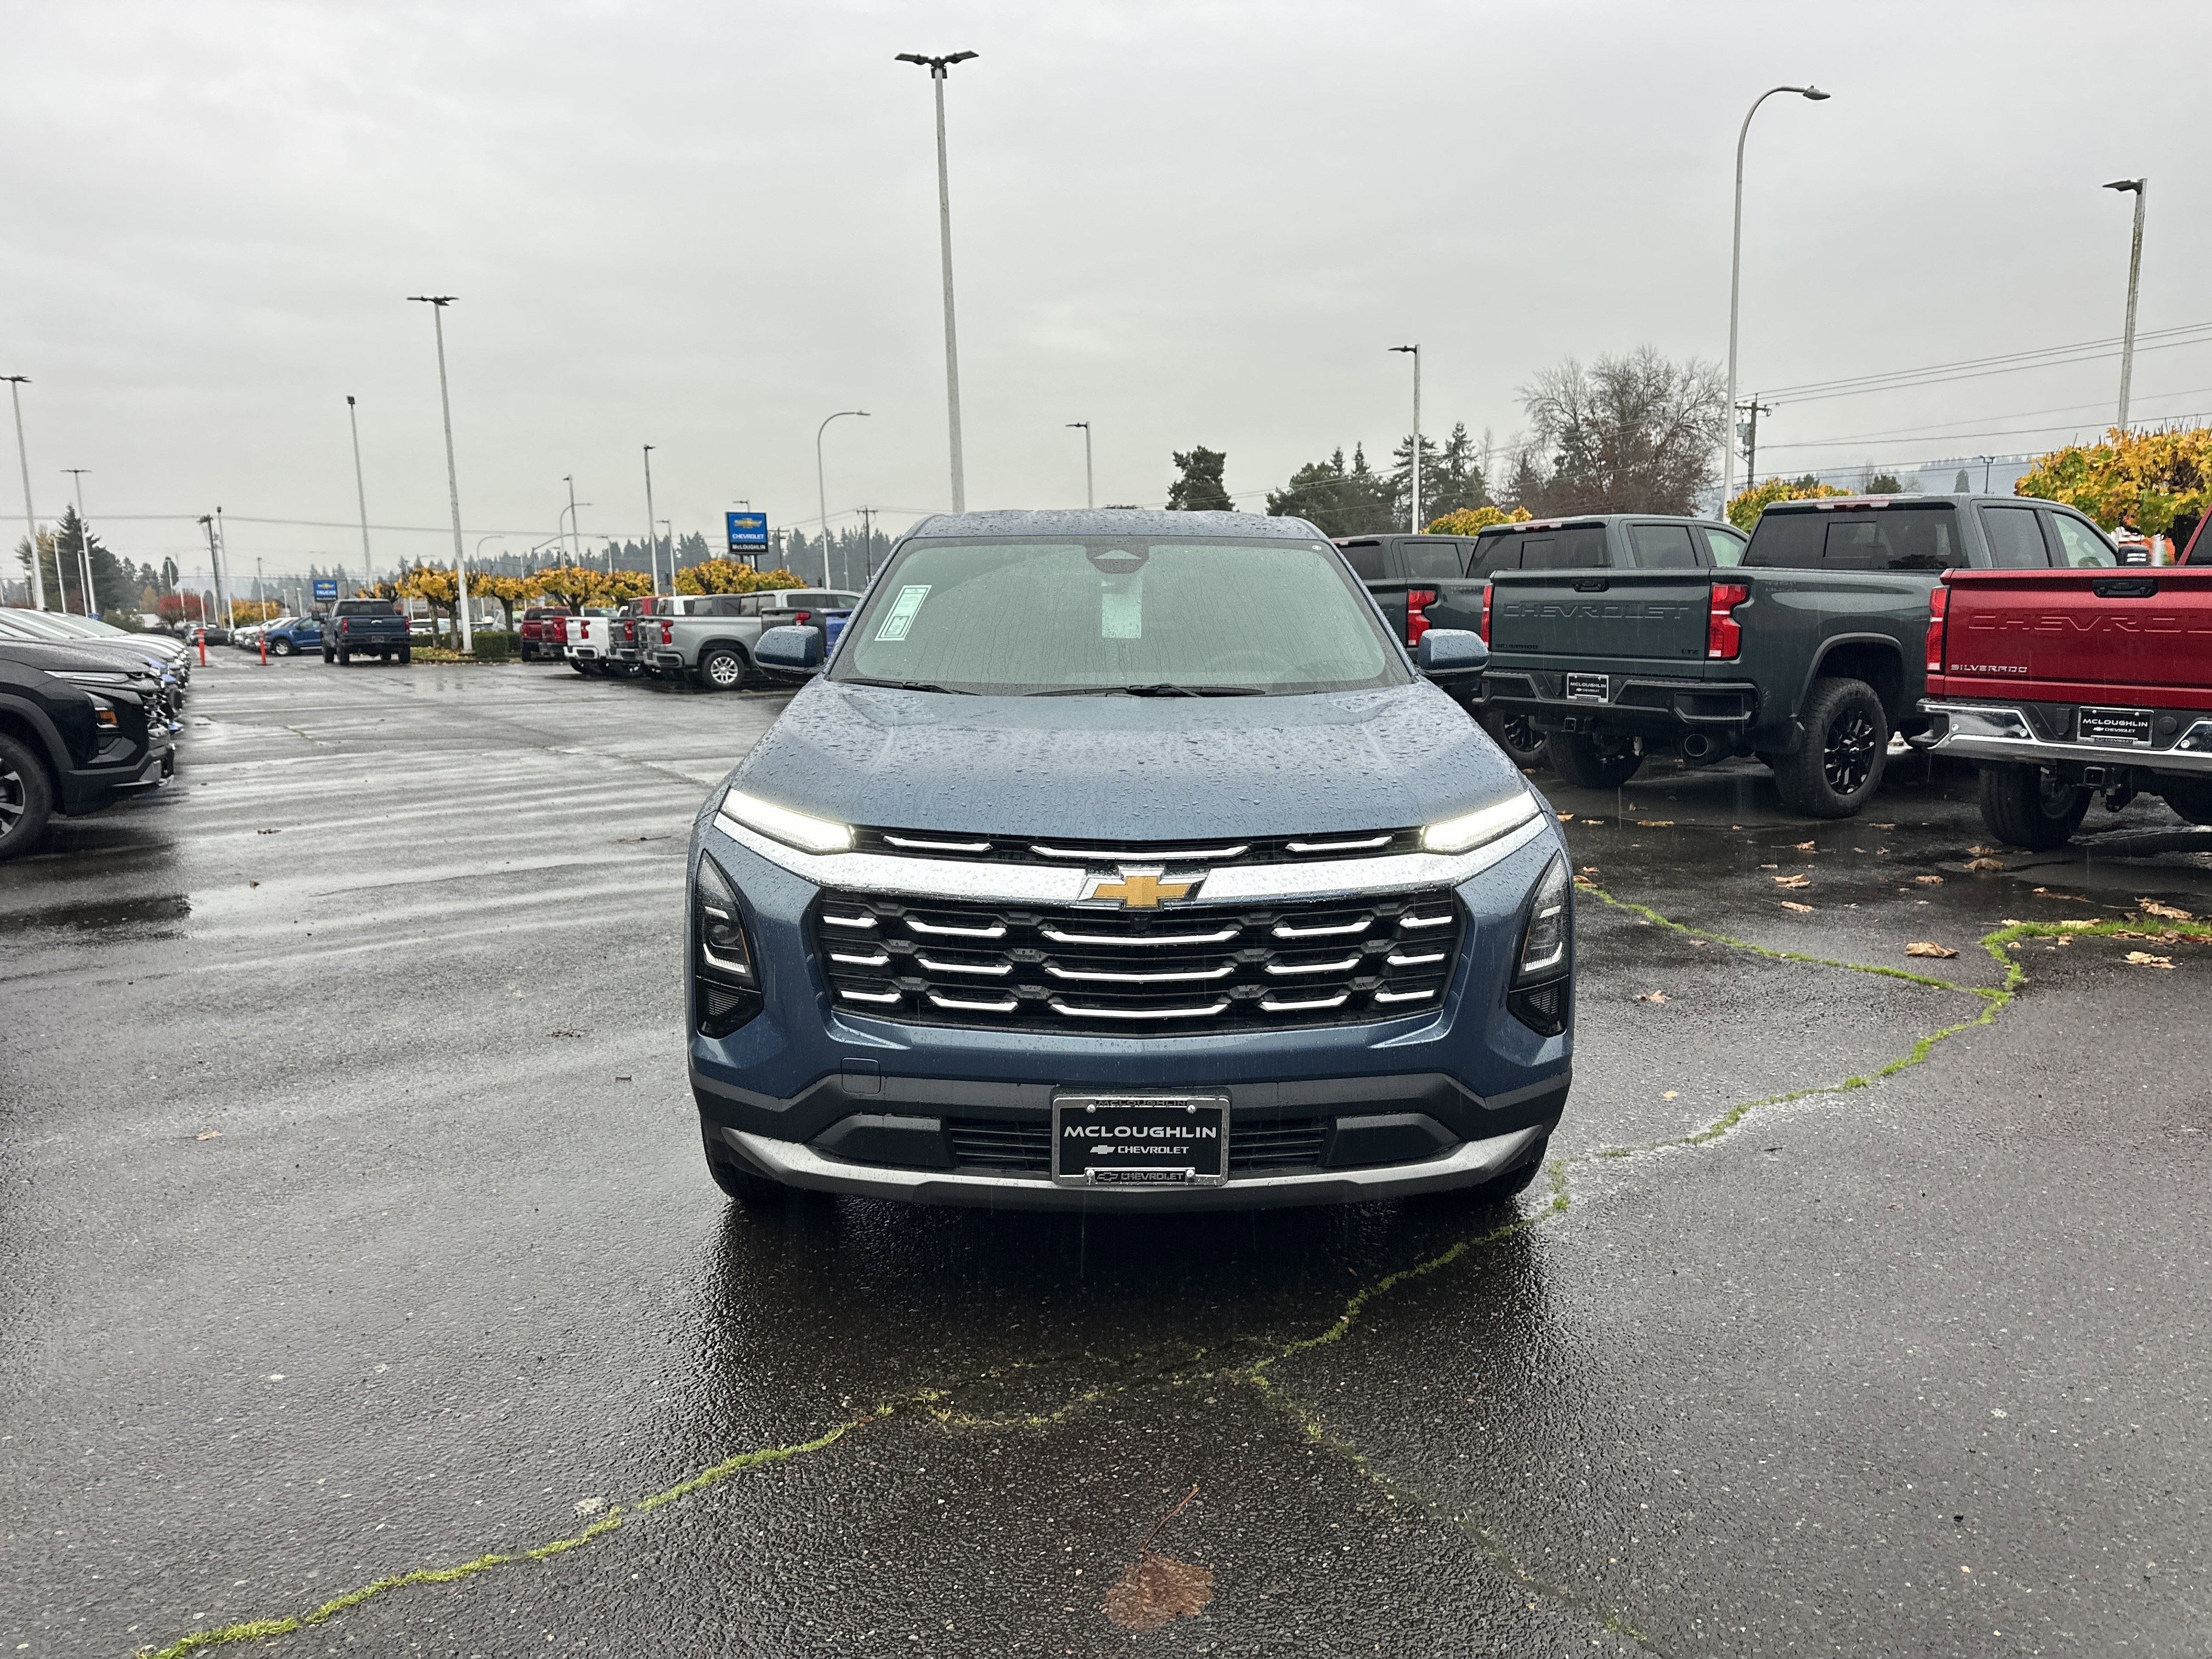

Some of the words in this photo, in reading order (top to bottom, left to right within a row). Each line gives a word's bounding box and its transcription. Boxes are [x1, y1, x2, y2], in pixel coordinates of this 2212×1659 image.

[1504, 604, 1689, 619] CHEVROLET
[1951, 664, 2028, 673] SILVERADO
[2083, 719, 2148, 727] MCLOUGHLIN
[1064, 1126, 1216, 1138] MCLOUGHLIN
[1118, 1146, 1189, 1154] CHEVROLET
